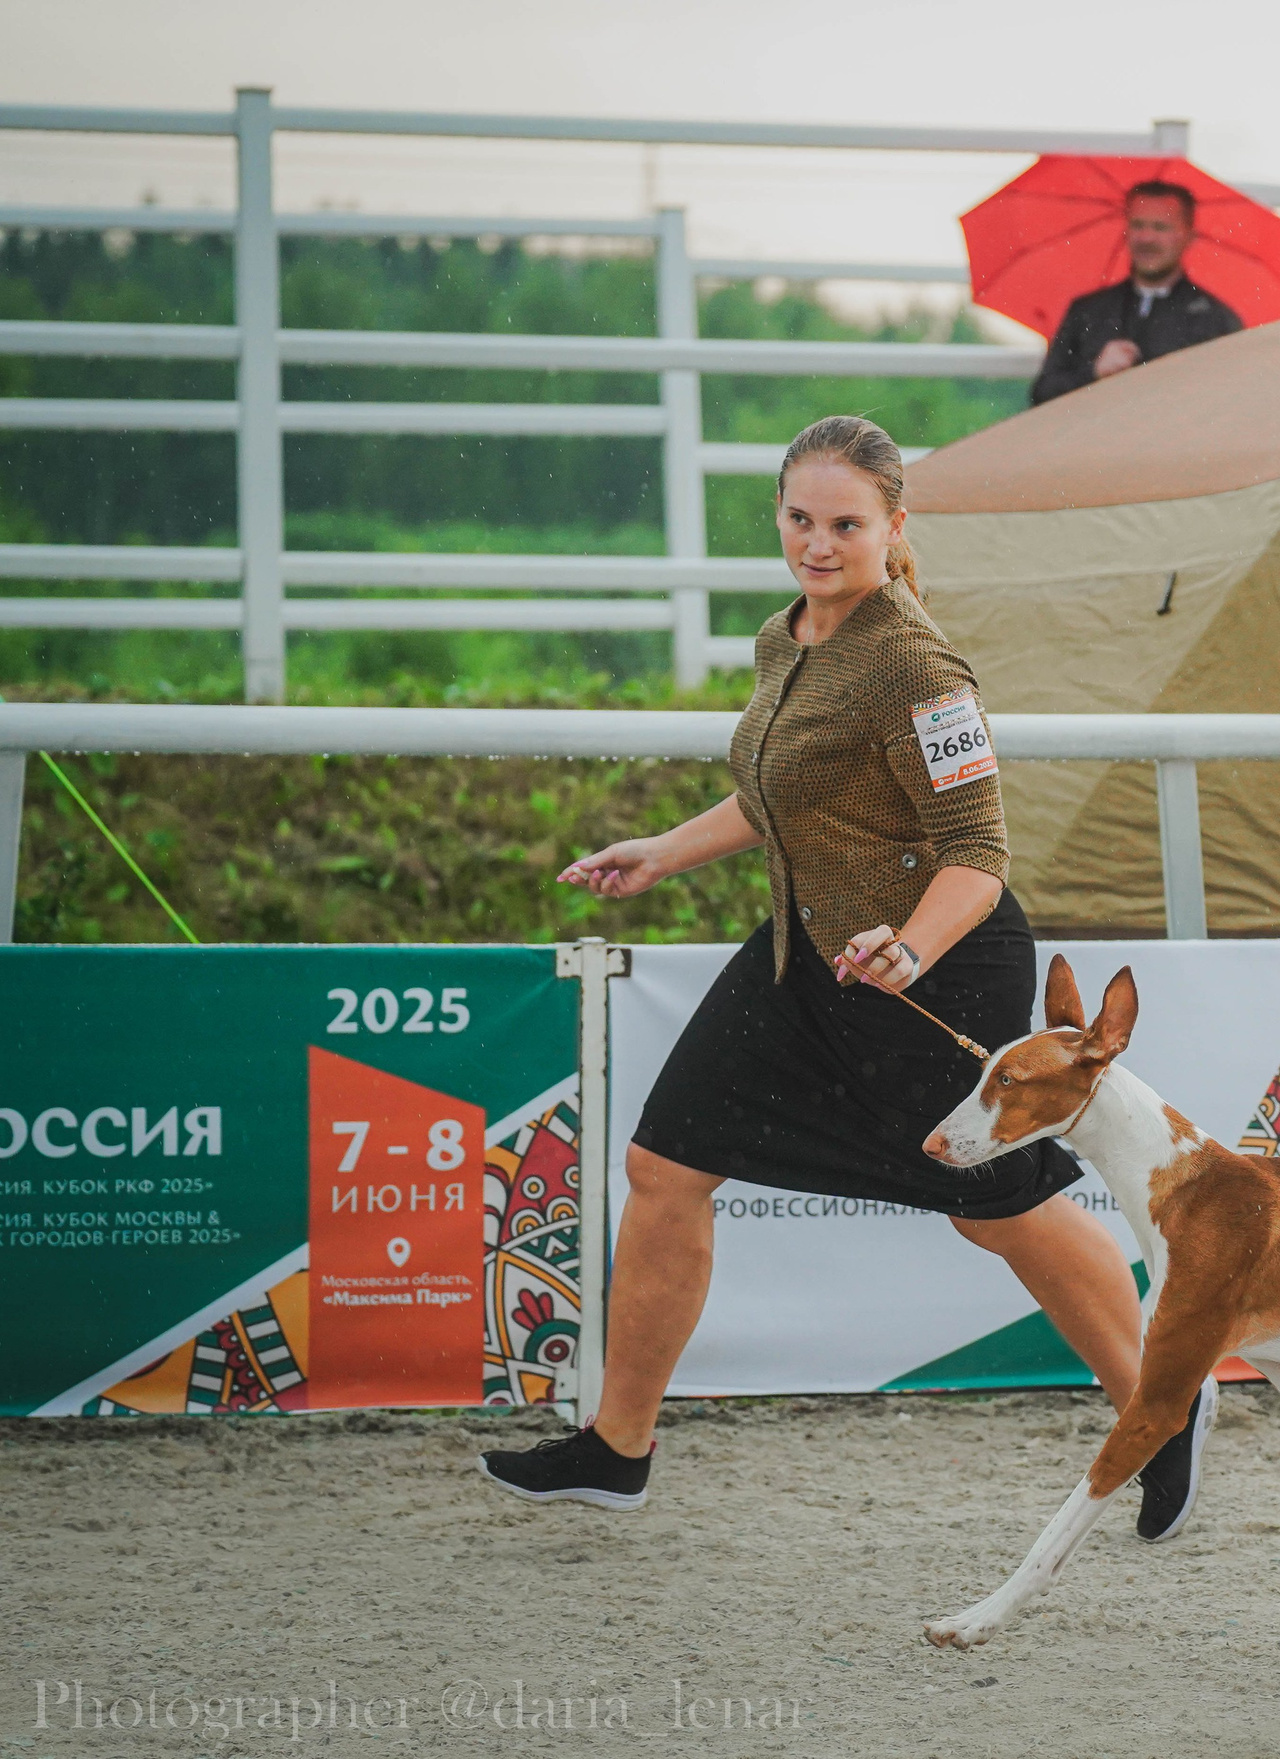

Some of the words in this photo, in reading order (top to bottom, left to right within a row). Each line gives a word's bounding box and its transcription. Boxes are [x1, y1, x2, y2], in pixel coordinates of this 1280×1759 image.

[926, 727, 986, 763] 2686
[963, 760, 993, 775] 8.06.2025
[326, 987, 471, 1034] 2025
[332, 1121, 370, 1172] 7
[387, 1145, 409, 1156] -
[426, 1119, 466, 1171] 8
[44, 1179, 109, 1195] КУБОК
[115, 1179, 155, 1195] РКФ
[161, 1178, 213, 1194] 2025»
[332, 1183, 465, 1213] ИЮНЯ
[44, 1211, 109, 1227] КУБОК
[115, 1211, 201, 1227] МОСКВЫ
[207, 1210, 220, 1226] &
[10, 1229, 182, 1247] ГОРОДОВ-ГЕРОЕВ
[188, 1228, 240, 1245] 2025»
[321, 1275, 409, 1288] Московская
[323, 1290, 413, 1306] «Максима
[416, 1288, 473, 1308] Парк»
